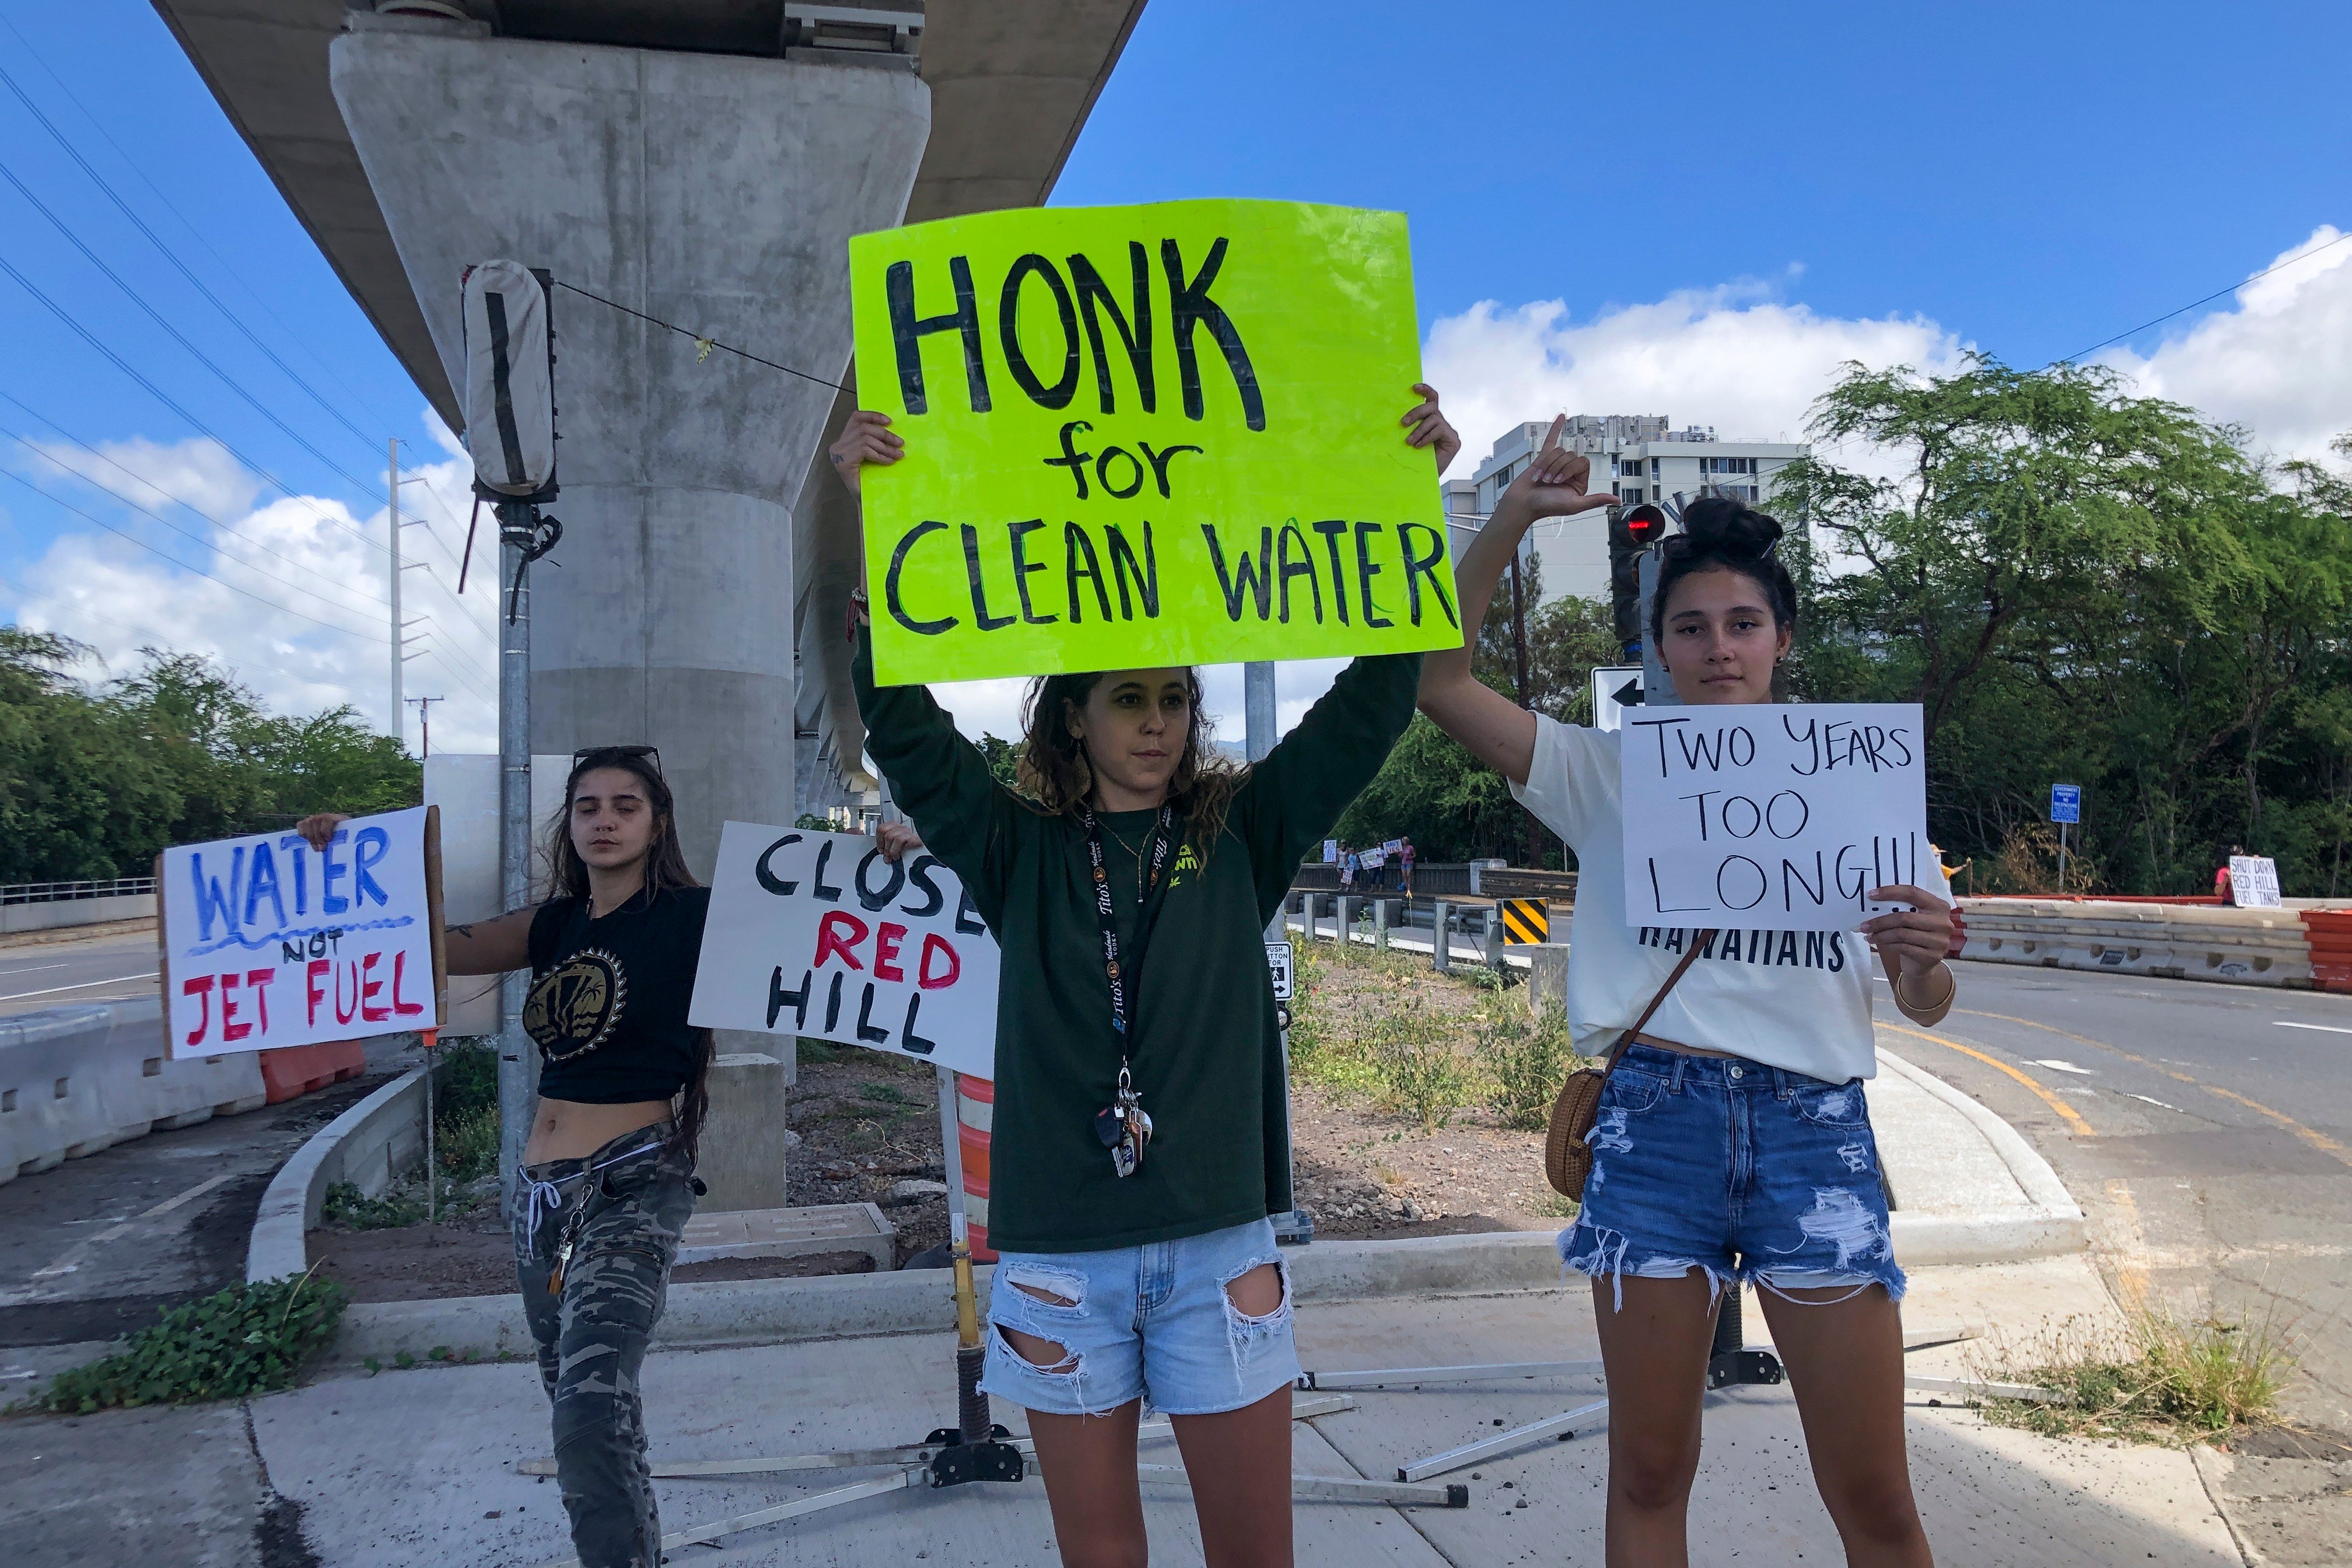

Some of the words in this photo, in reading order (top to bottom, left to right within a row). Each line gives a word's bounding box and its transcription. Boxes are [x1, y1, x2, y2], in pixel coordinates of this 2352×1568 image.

[887, 237, 1266, 432] HONK
[1044, 421, 1205, 500] for
[886, 519, 1160, 635] CLEAN
[1202, 519, 1459, 631] WATER
[1632, 718, 1755, 778] TWO
[1783, 714, 1912, 775] YEARS
[1679, 790, 1808, 841] TOO
[190, 827, 391, 941] WATER
[756, 834, 987, 939] CLOSE
[2232, 858, 2250, 874] SHUT
[2254, 860, 2274, 874] DOWN
[2233, 874, 2250, 889] RED
[2255, 876, 2277, 890] HILL
[2235, 890, 2254, 905] FUEL
[2257, 891, 2280, 906] TANKS
[282, 928, 344, 964] NOT
[813, 910, 961, 990] RED
[183, 968, 275, 1046] JET
[307, 950, 424, 1028] FUEL
[766, 965, 936, 1055] HILL
